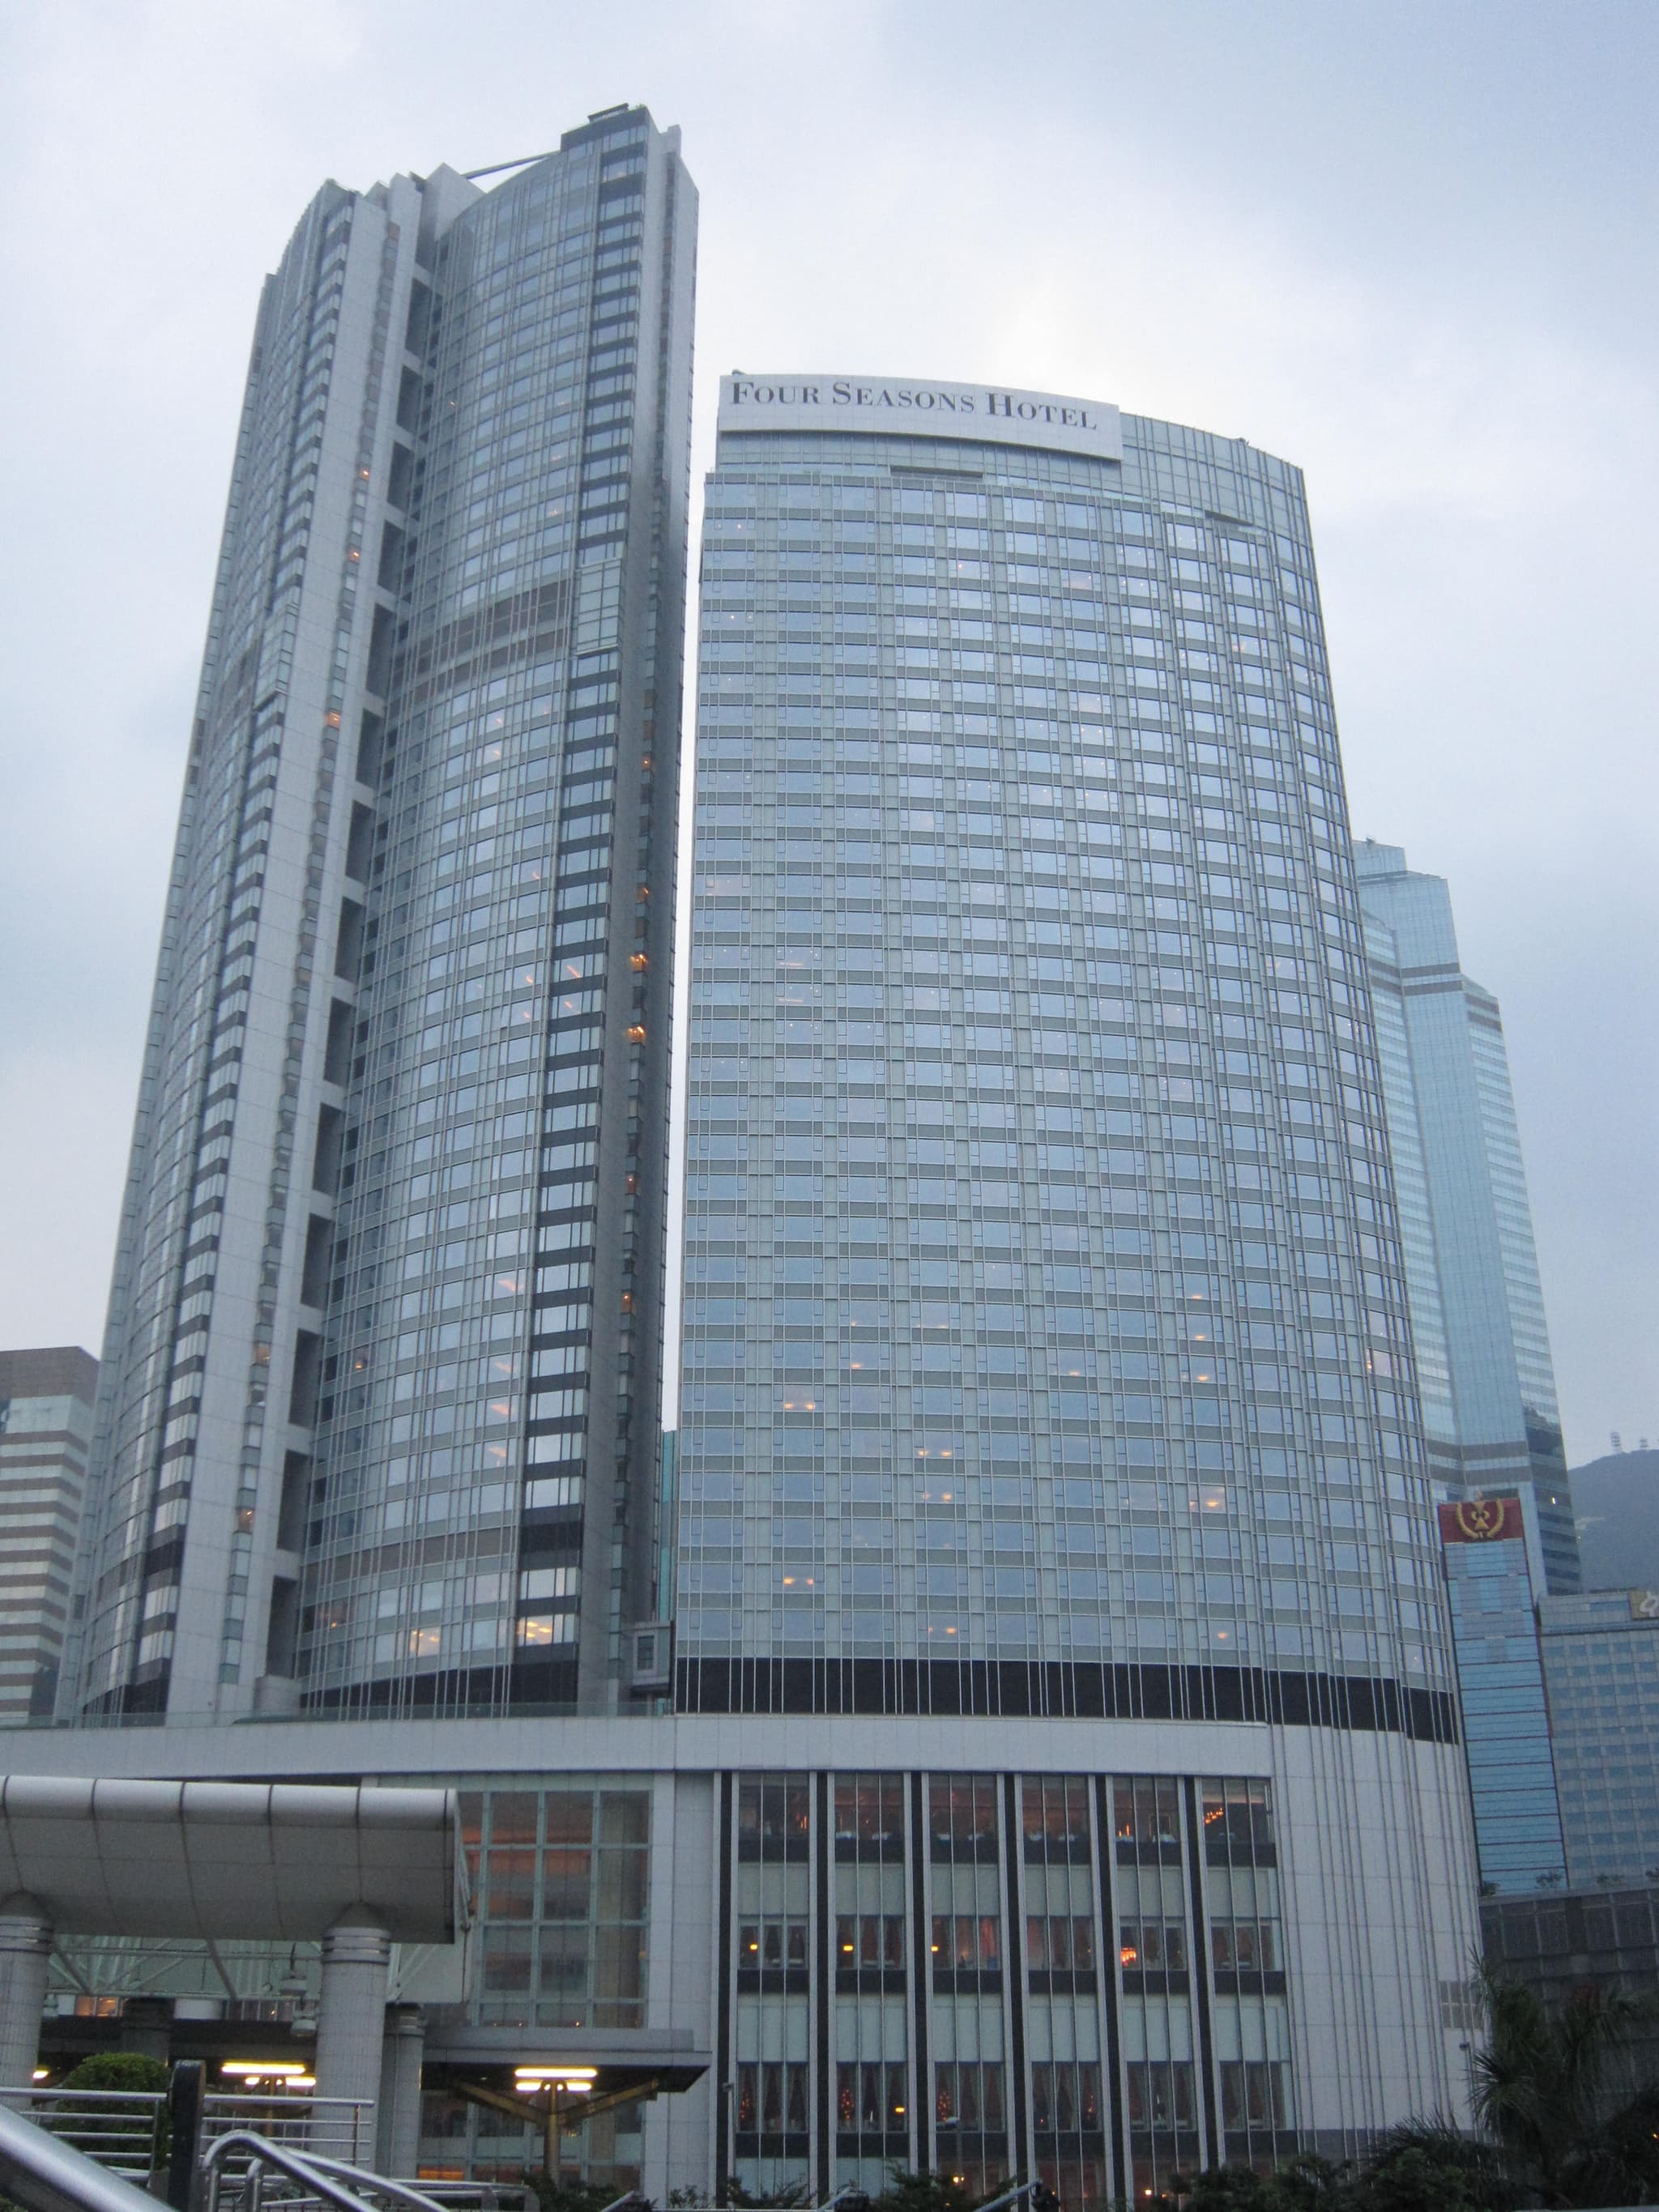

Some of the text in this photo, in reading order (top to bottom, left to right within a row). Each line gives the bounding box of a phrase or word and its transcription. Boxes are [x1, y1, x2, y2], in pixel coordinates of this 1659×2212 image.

[731, 381, 1097, 429] FOUR SEASONS HOTEL
